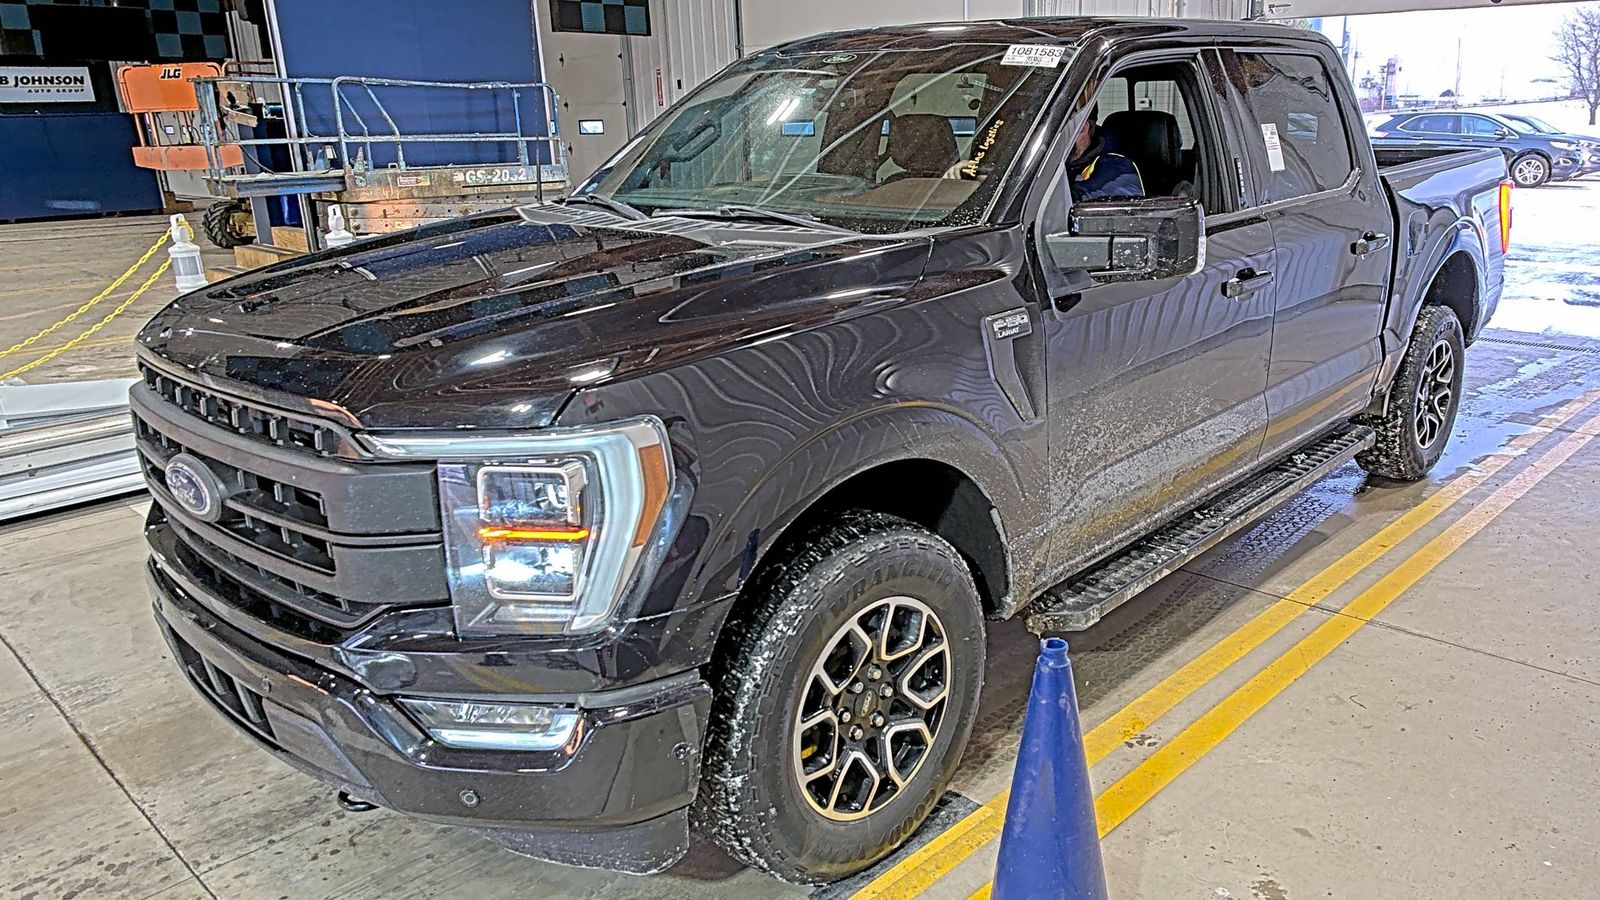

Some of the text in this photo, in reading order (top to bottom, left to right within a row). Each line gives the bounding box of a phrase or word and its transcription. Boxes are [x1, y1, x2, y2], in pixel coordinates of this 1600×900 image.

[1011, 46, 1063, 57] 1081583
[160, 68, 181, 79] JLG
[13, 75, 85, 88] JOHNSON
[997, 327, 1019, 338] LARIAT
